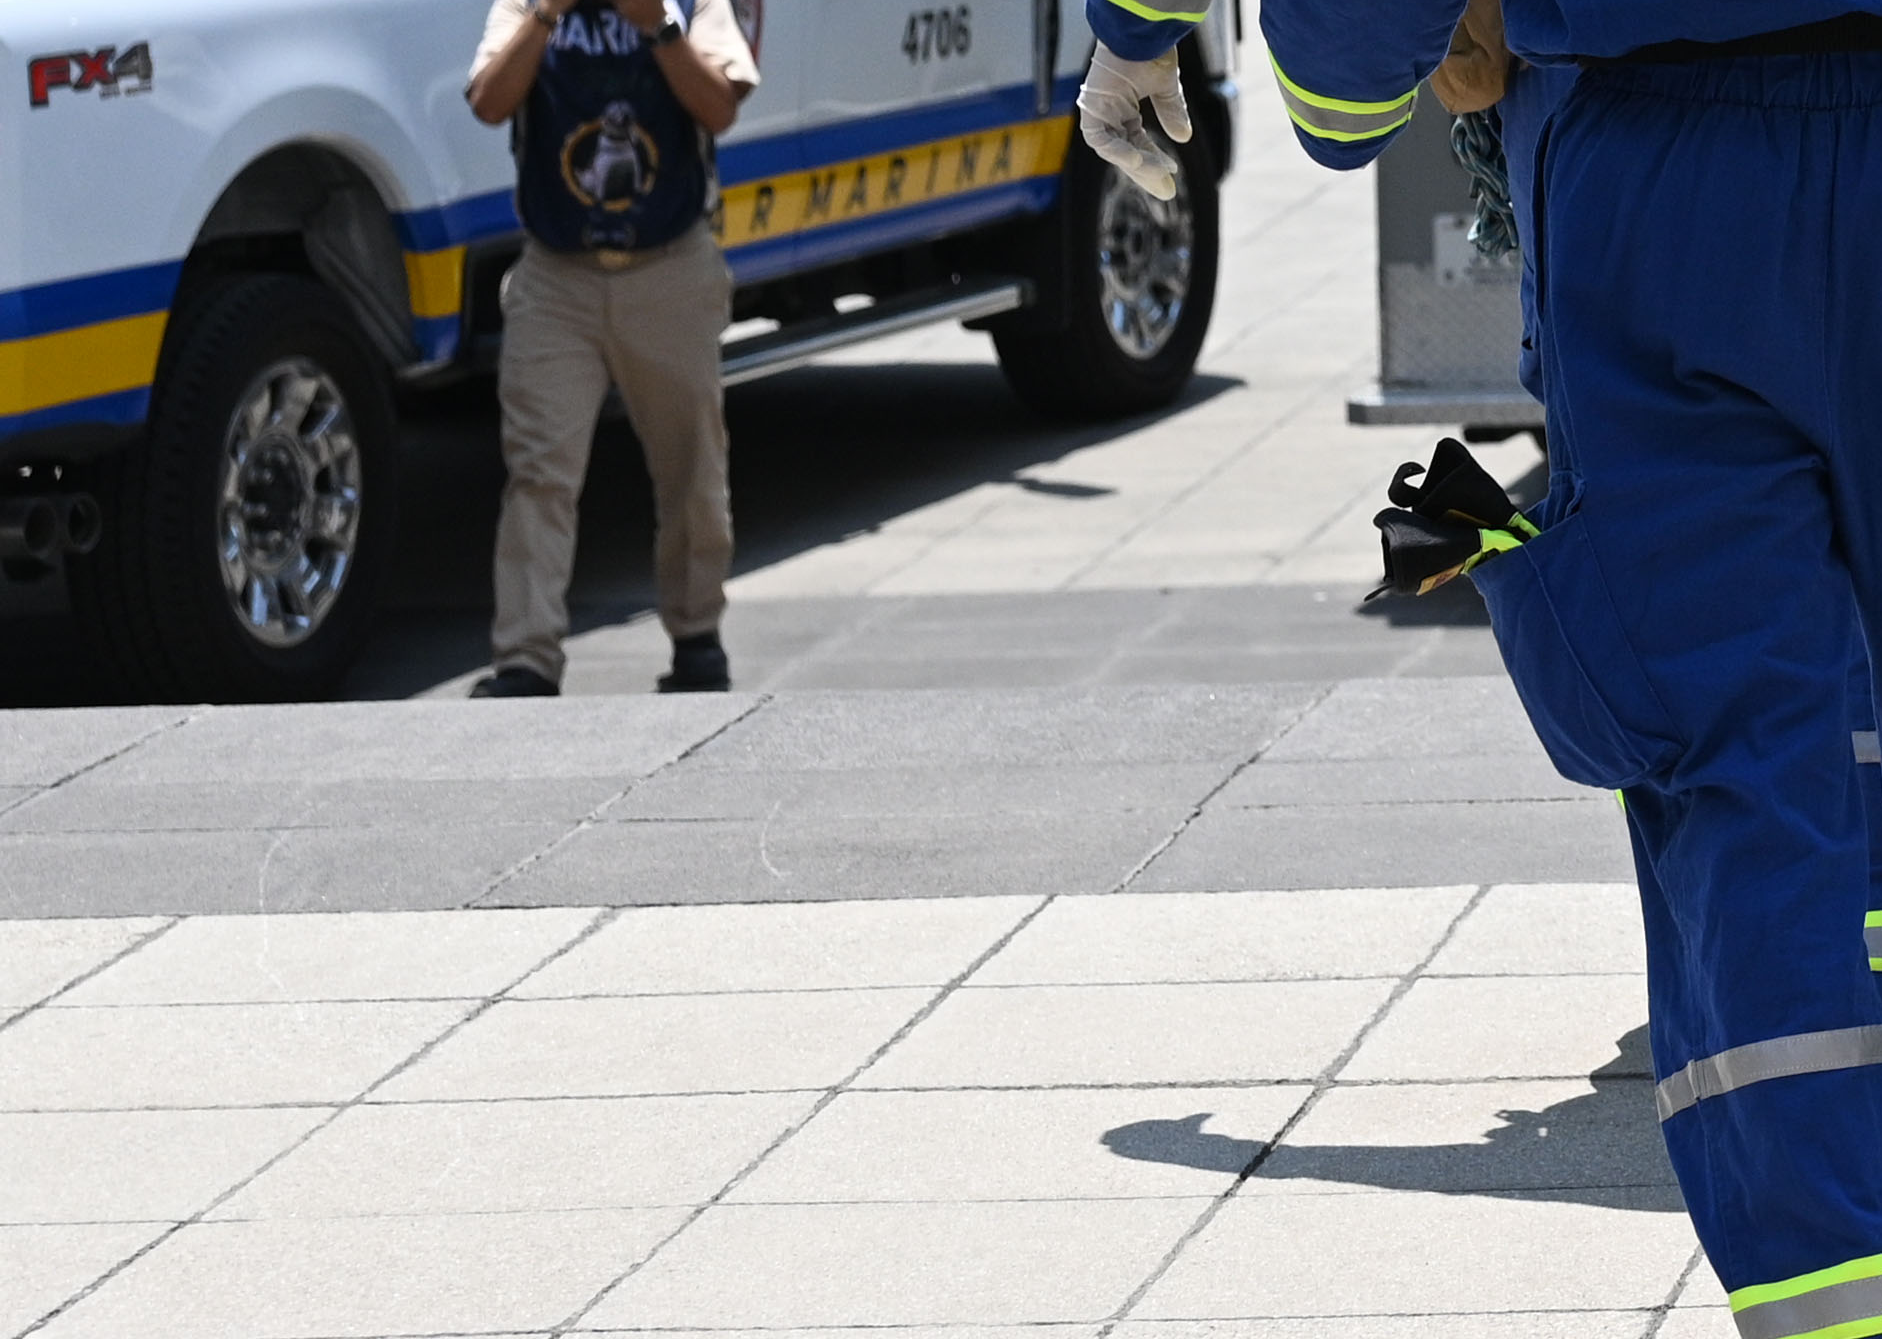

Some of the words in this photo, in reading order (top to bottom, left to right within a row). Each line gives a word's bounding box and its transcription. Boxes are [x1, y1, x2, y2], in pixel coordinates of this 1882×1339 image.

[902, 5, 973, 64] 4706
[28, 40, 153, 106] FX4
[804, 131, 1015, 222] MARINA
